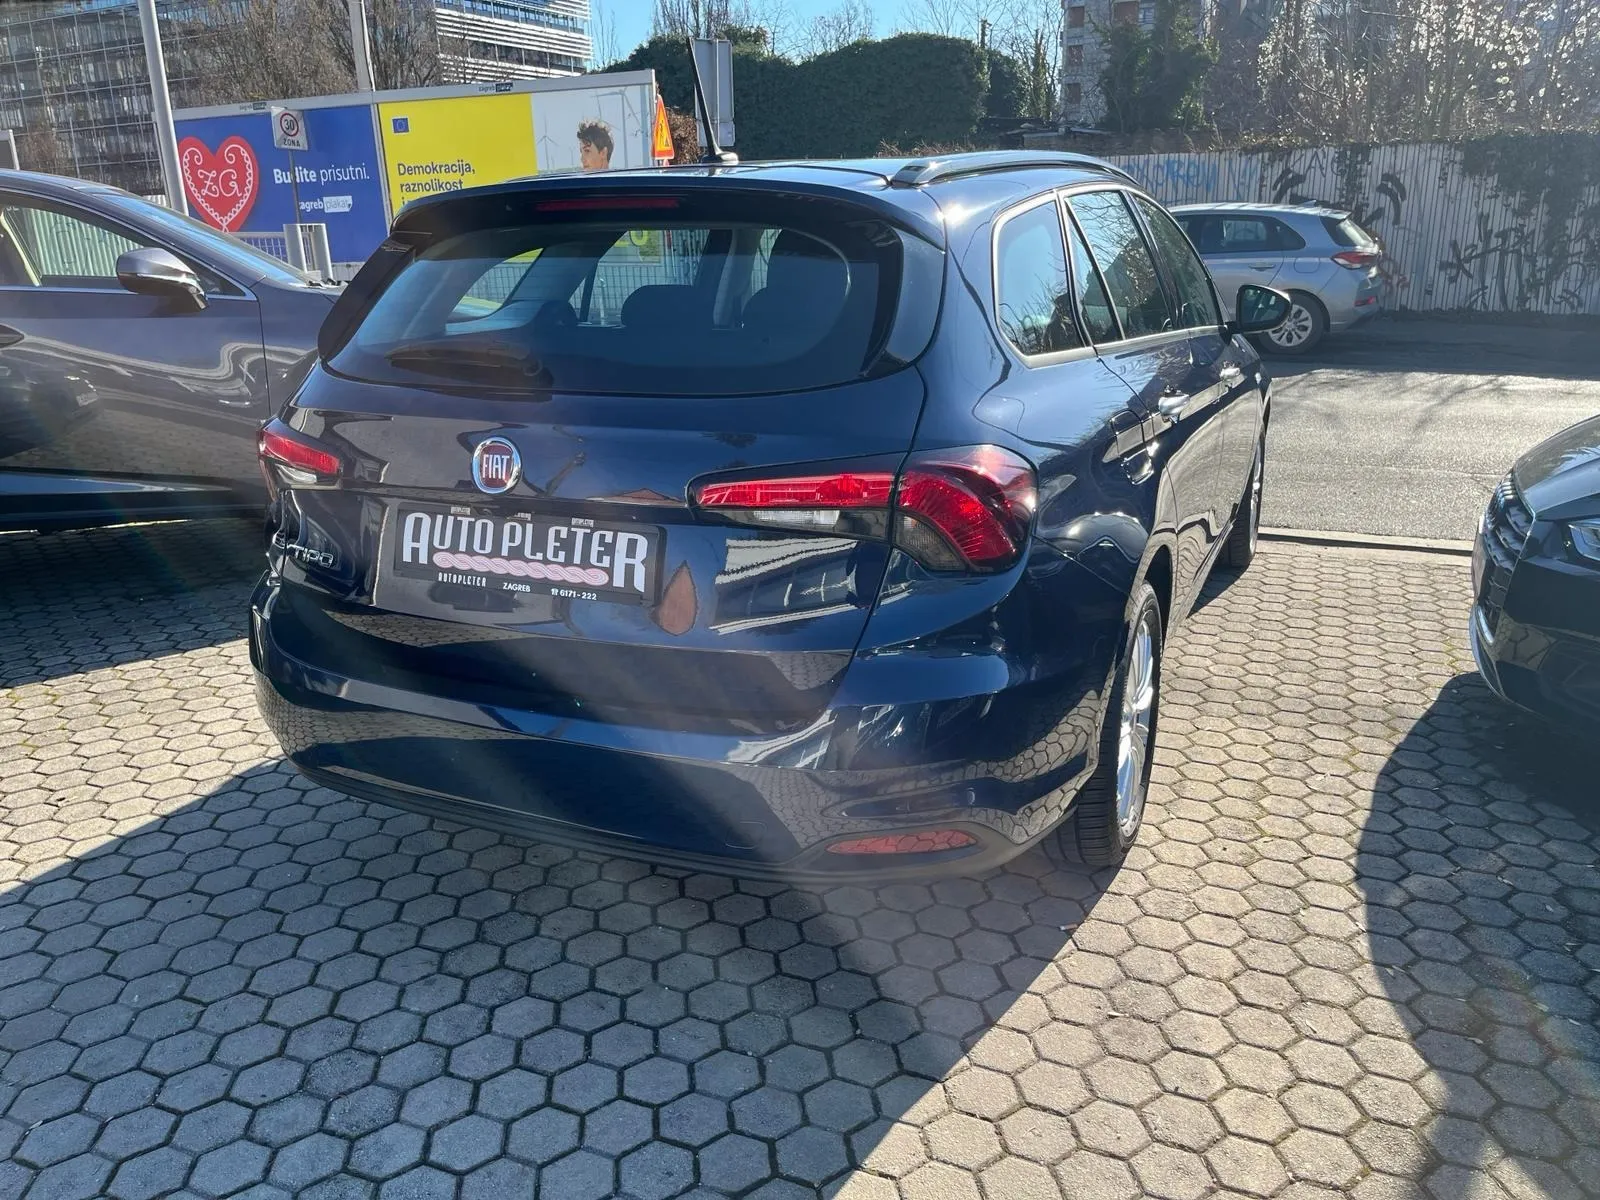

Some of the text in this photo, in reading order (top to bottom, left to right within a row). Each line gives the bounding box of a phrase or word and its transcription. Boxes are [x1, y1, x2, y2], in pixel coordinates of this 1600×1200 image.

[284, 119, 295, 131] 30
[283, 138, 301, 147] ZONA
[320, 162, 370, 186] prisutni.
[397, 159, 476, 176] Demokracija,
[400, 178, 463, 193] raznolikost
[482, 454, 510, 481] FIAT
[402, 512, 649, 593] AUTO PLETER
[438, 572, 598, 601] AUTOPLETER ZAGREB 6171-222
